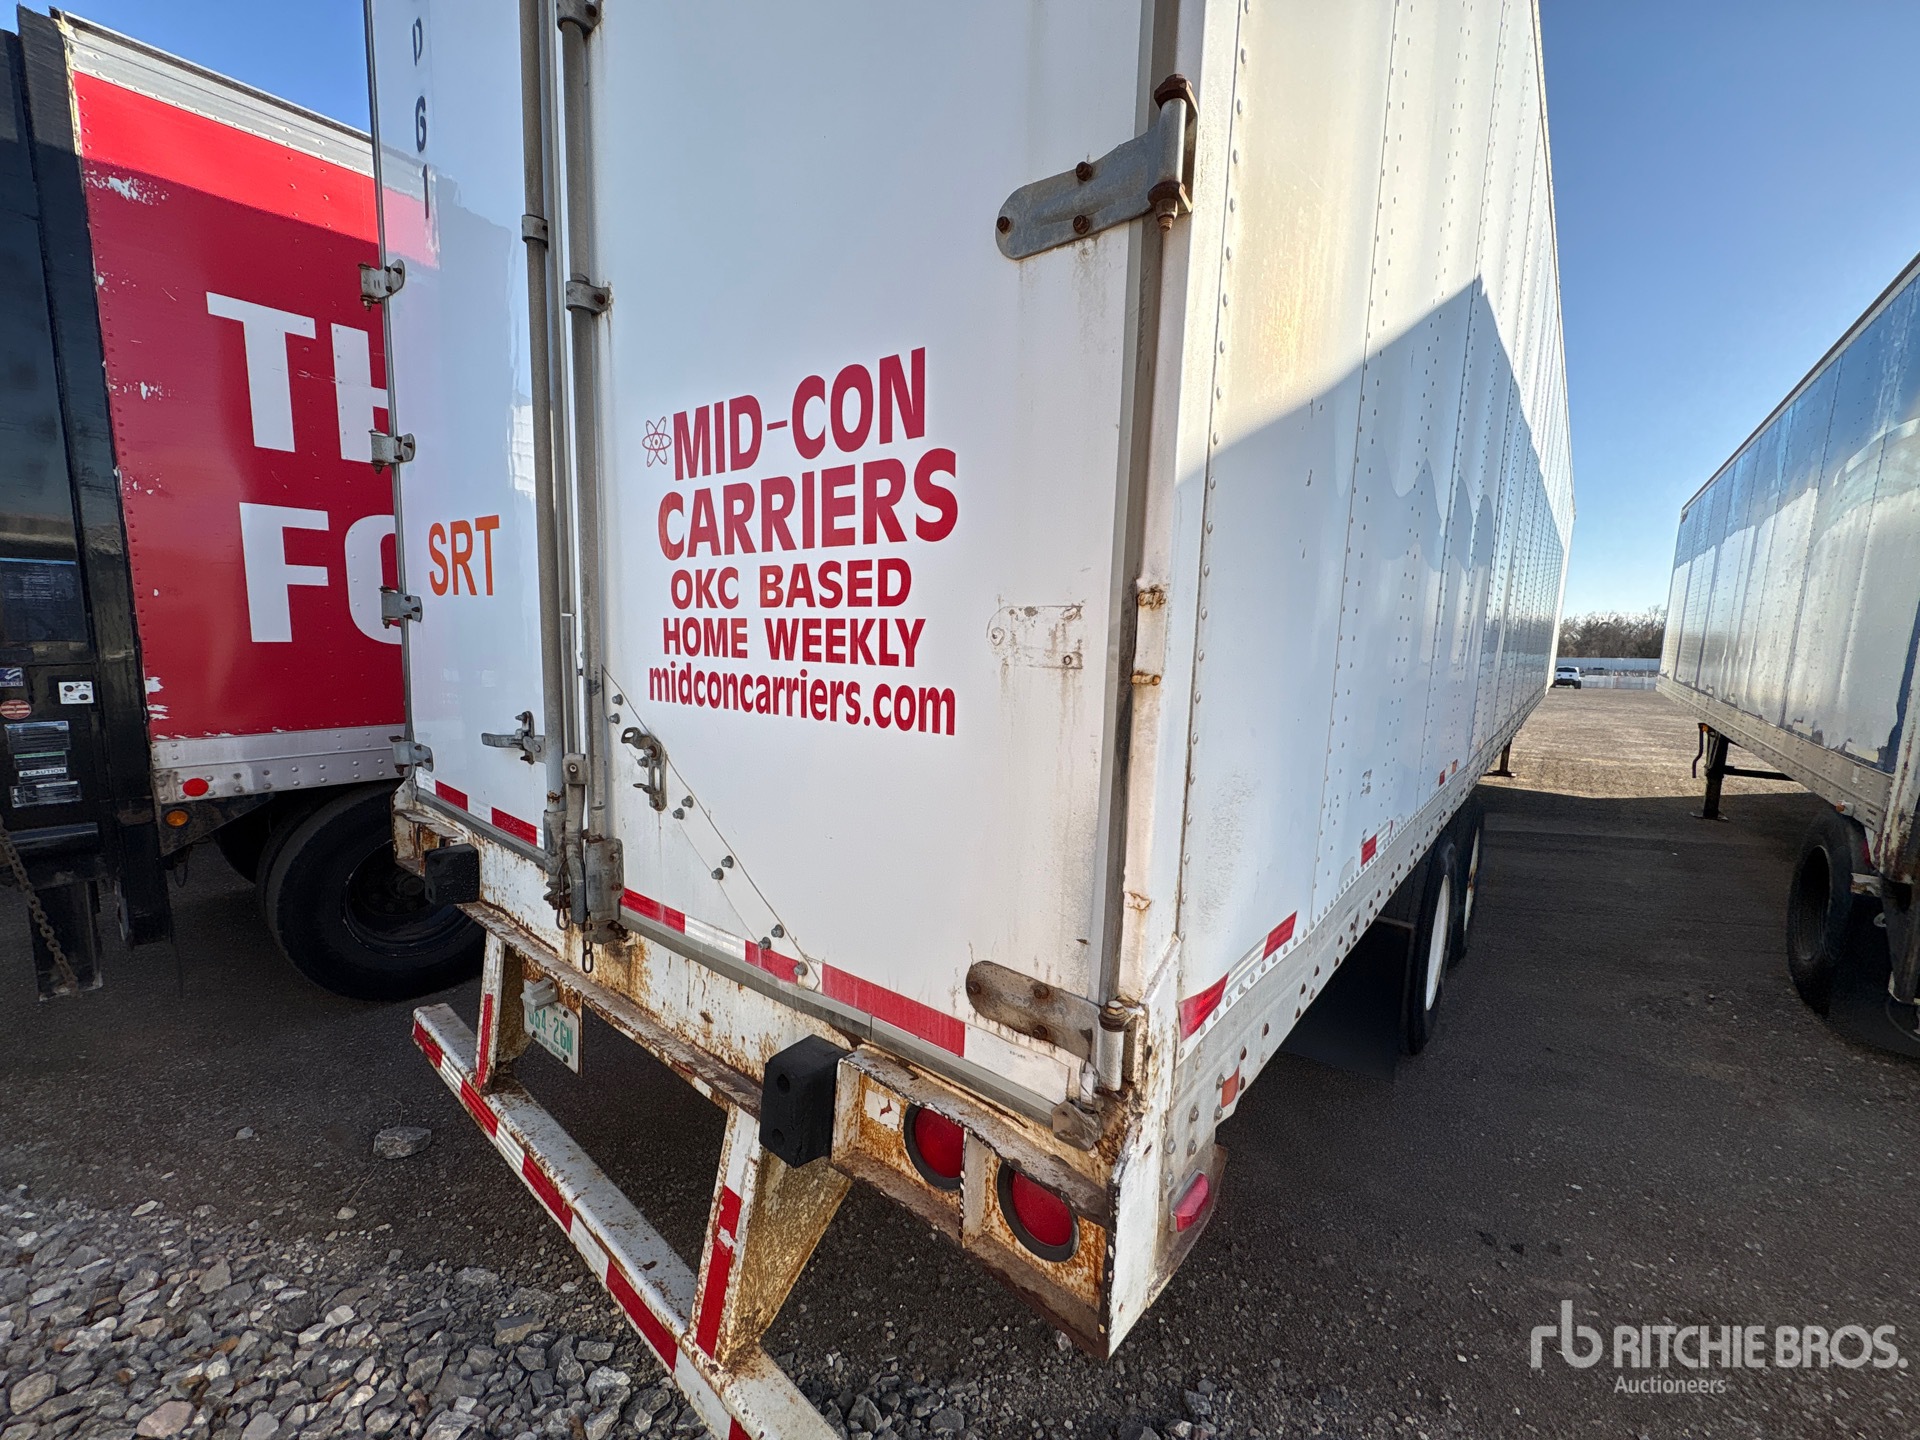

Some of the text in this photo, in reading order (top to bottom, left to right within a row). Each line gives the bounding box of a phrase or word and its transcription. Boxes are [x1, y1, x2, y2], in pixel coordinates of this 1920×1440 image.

[673, 346, 925, 481] MID-CON
[657, 447, 958, 561] CARRIERS
[428, 514, 500, 597] SRT
[670, 557, 912, 610] OKC BASED
[662, 616, 926, 668] HOME WEEKLY
[648, 661, 955, 736] midconcarriers.com
